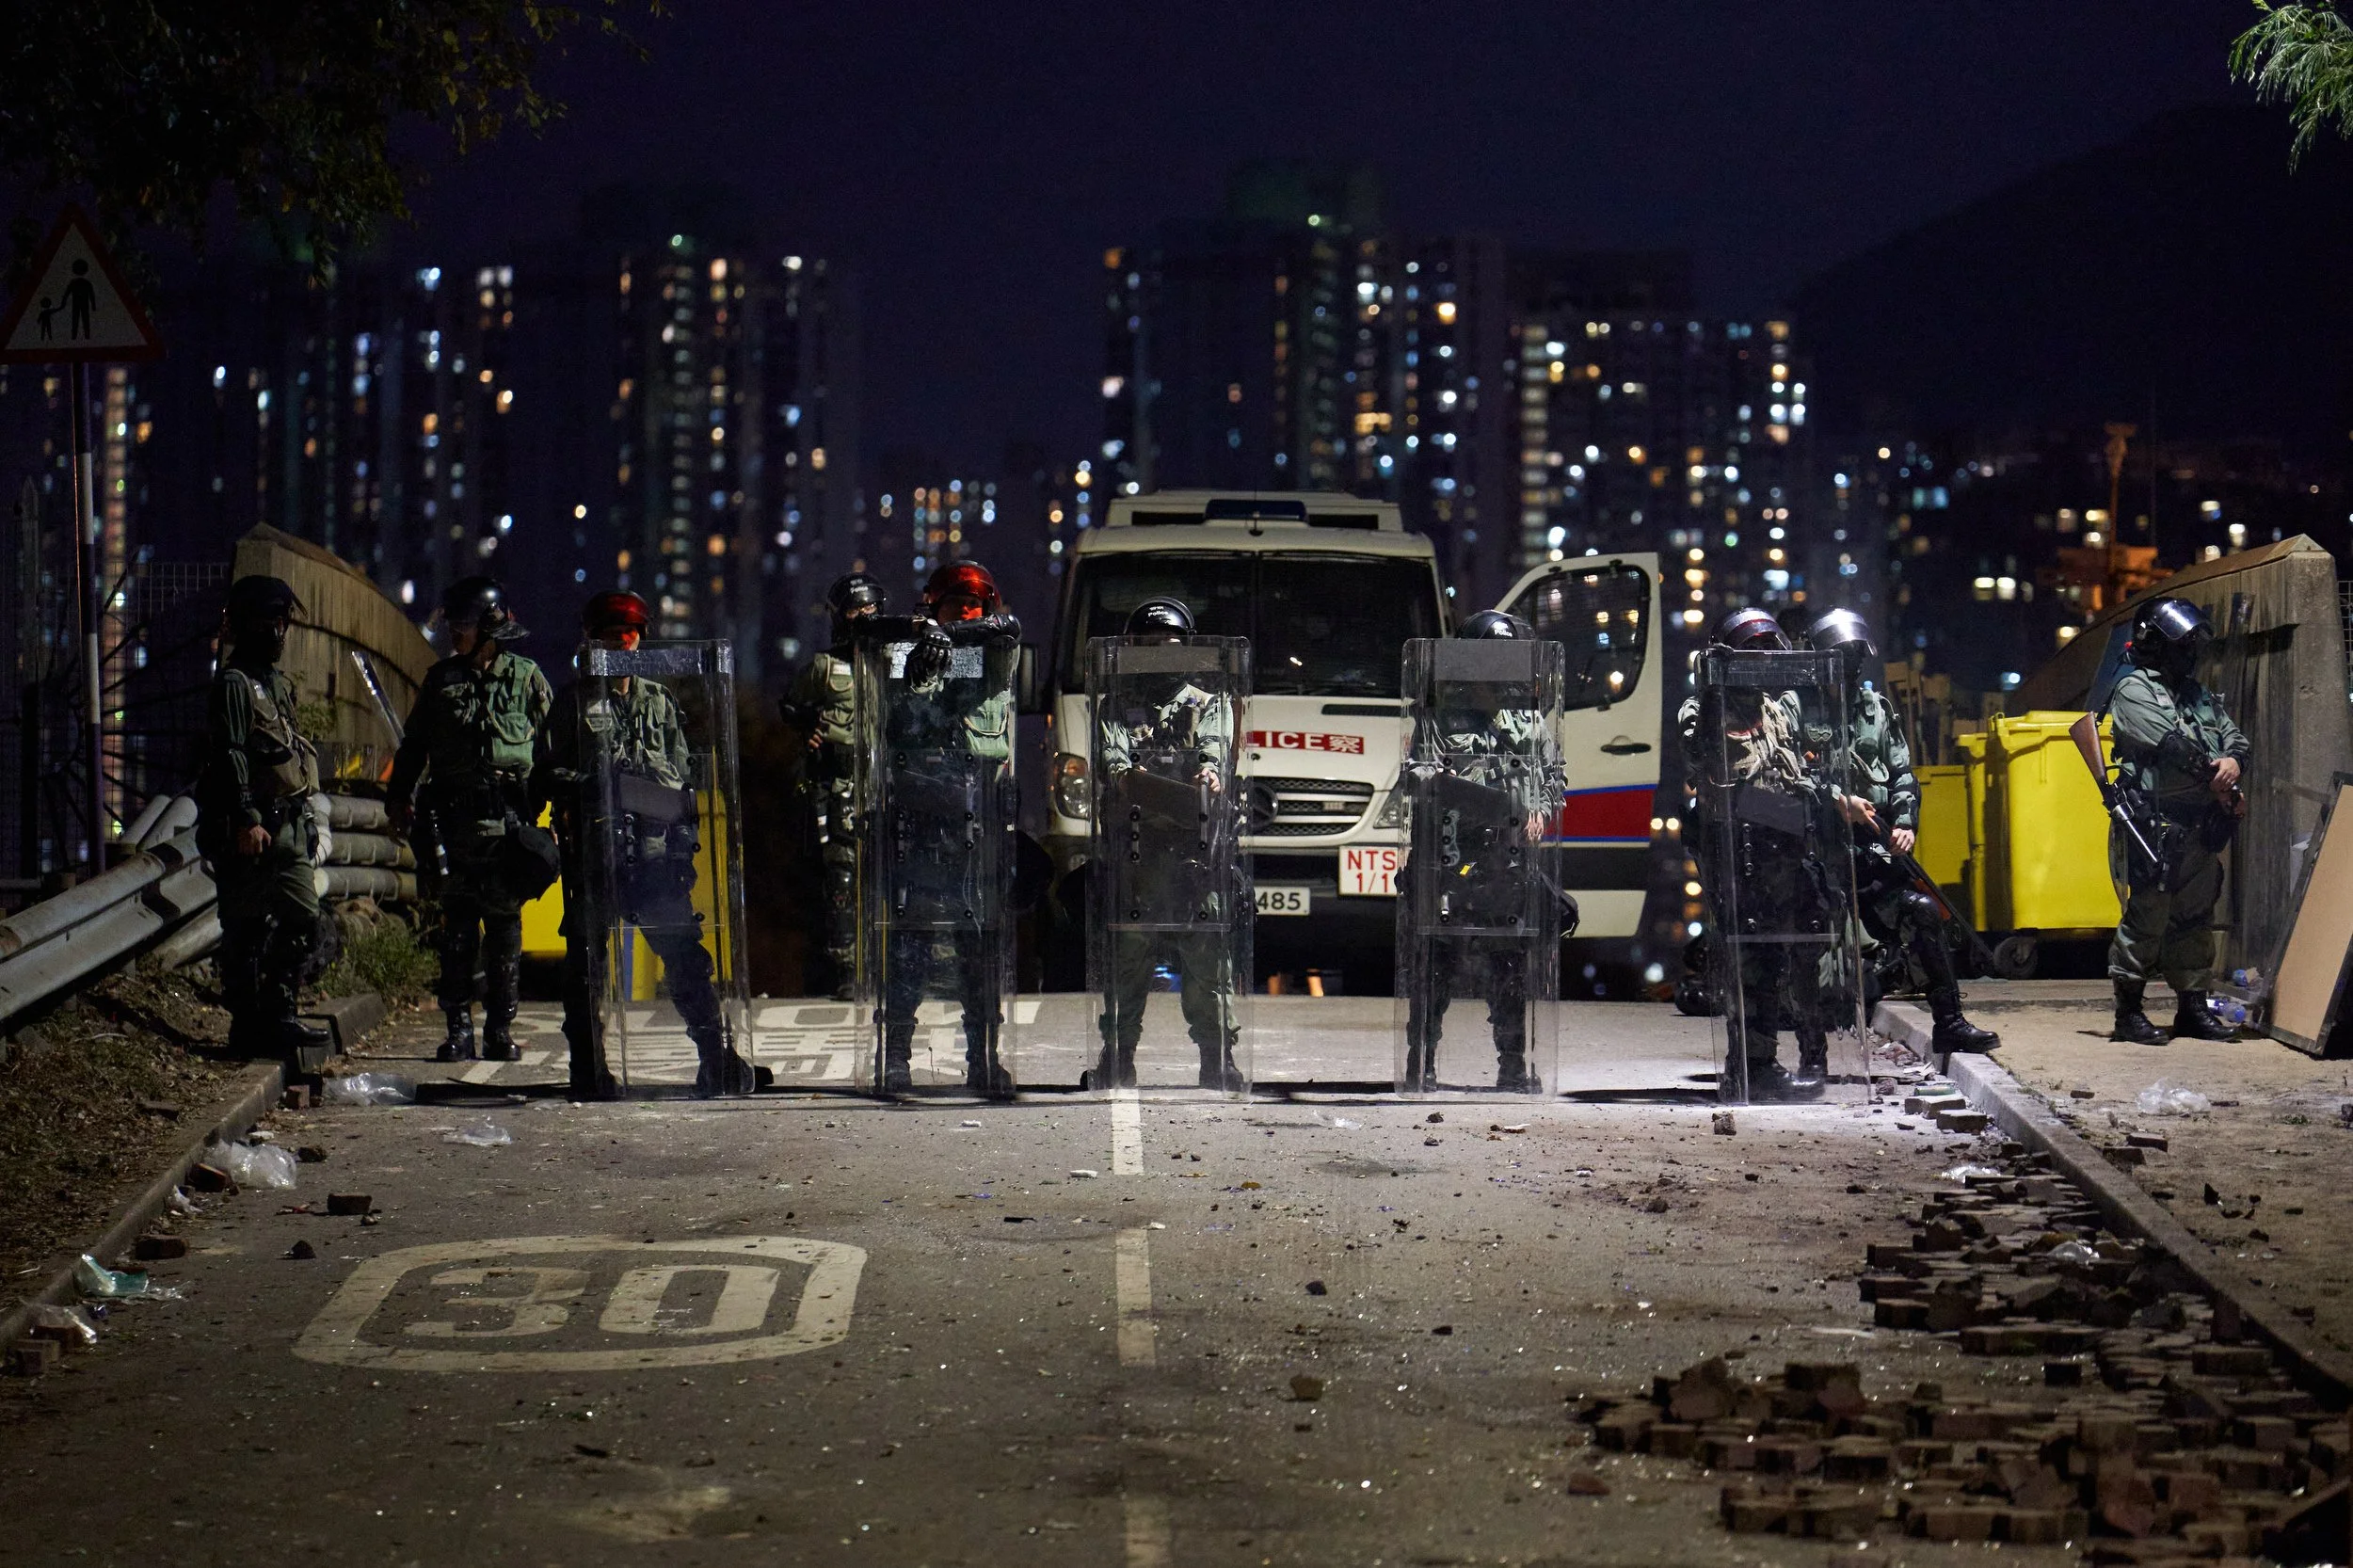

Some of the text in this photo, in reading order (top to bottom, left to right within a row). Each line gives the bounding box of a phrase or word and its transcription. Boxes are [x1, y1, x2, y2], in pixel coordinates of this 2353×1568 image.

[1494, 629, 1513, 638] Police
[1246, 731, 1360, 754] ICE 察
[1347, 850, 1396, 871] NTS
[1356, 872, 1388, 893] 1/1
[404, 1265, 780, 1338] 30
